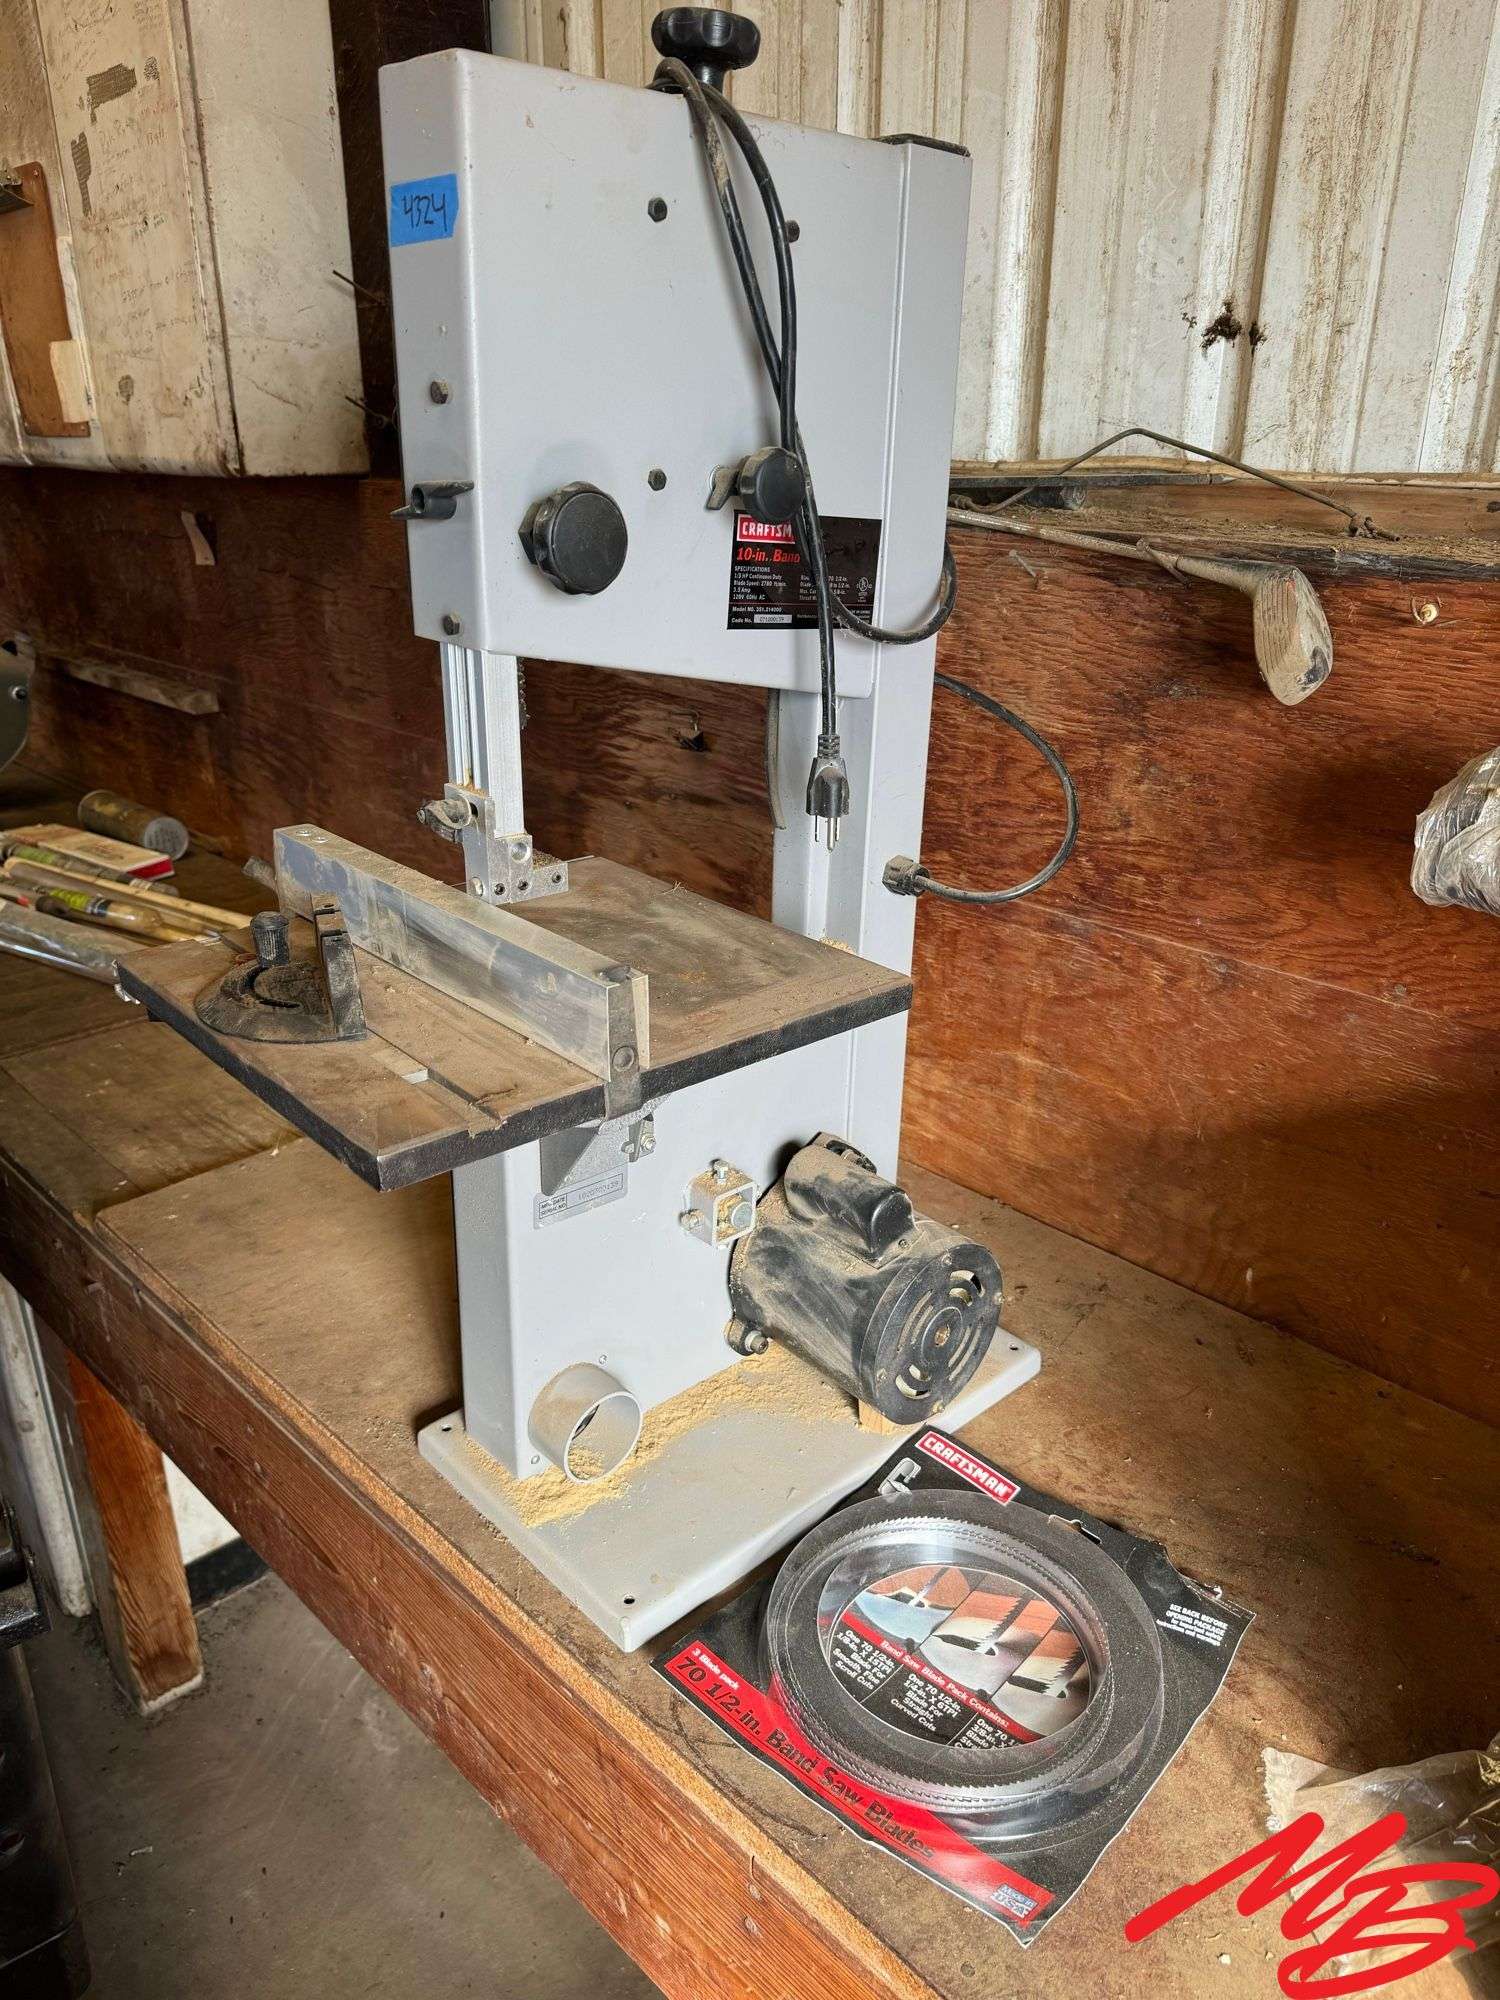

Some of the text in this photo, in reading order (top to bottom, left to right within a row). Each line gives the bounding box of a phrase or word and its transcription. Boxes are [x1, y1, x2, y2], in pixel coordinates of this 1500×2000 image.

[401, 193, 448, 232] 4324
[742, 521, 792, 538] CRAFTSM
[923, 1437, 1009, 1497] CRAFTSMAN
[1181, 1607, 1201, 1619] BACK
[1193, 1619, 1226, 1636] PACKAGE
[845, 1630, 860, 1644] One
[861, 1640, 873, 1652] 70
[692, 1647, 701, 1657] 3
[699, 1653, 721, 1675] Blade
[859, 1649, 869, 1658] X
[835, 1660, 875, 1690] Scroll Cuts
[850, 1652, 887, 1679] Blade For
[863, 1670, 880, 1684] Fine
[881, 1639, 903, 1657] Band
[902, 1654, 921, 1670] Saw
[921, 1666, 946, 1686] Blade
[946, 1682, 969, 1702] Pack
[908, 1673, 924, 1687] One
[925, 1683, 938, 1695] 70
[890, 1698, 937, 1732] Curved Cuts
[906, 1690, 944, 1717] Blade For
[928, 1695, 938, 1704] X
[937, 1701, 958, 1718] 6TPI
[966, 1730, 989, 1748] Blade
[977, 1718, 1008, 1741] One 70
[677, 1656, 936, 1859] 70 1/2-in. Band Saw Blades
